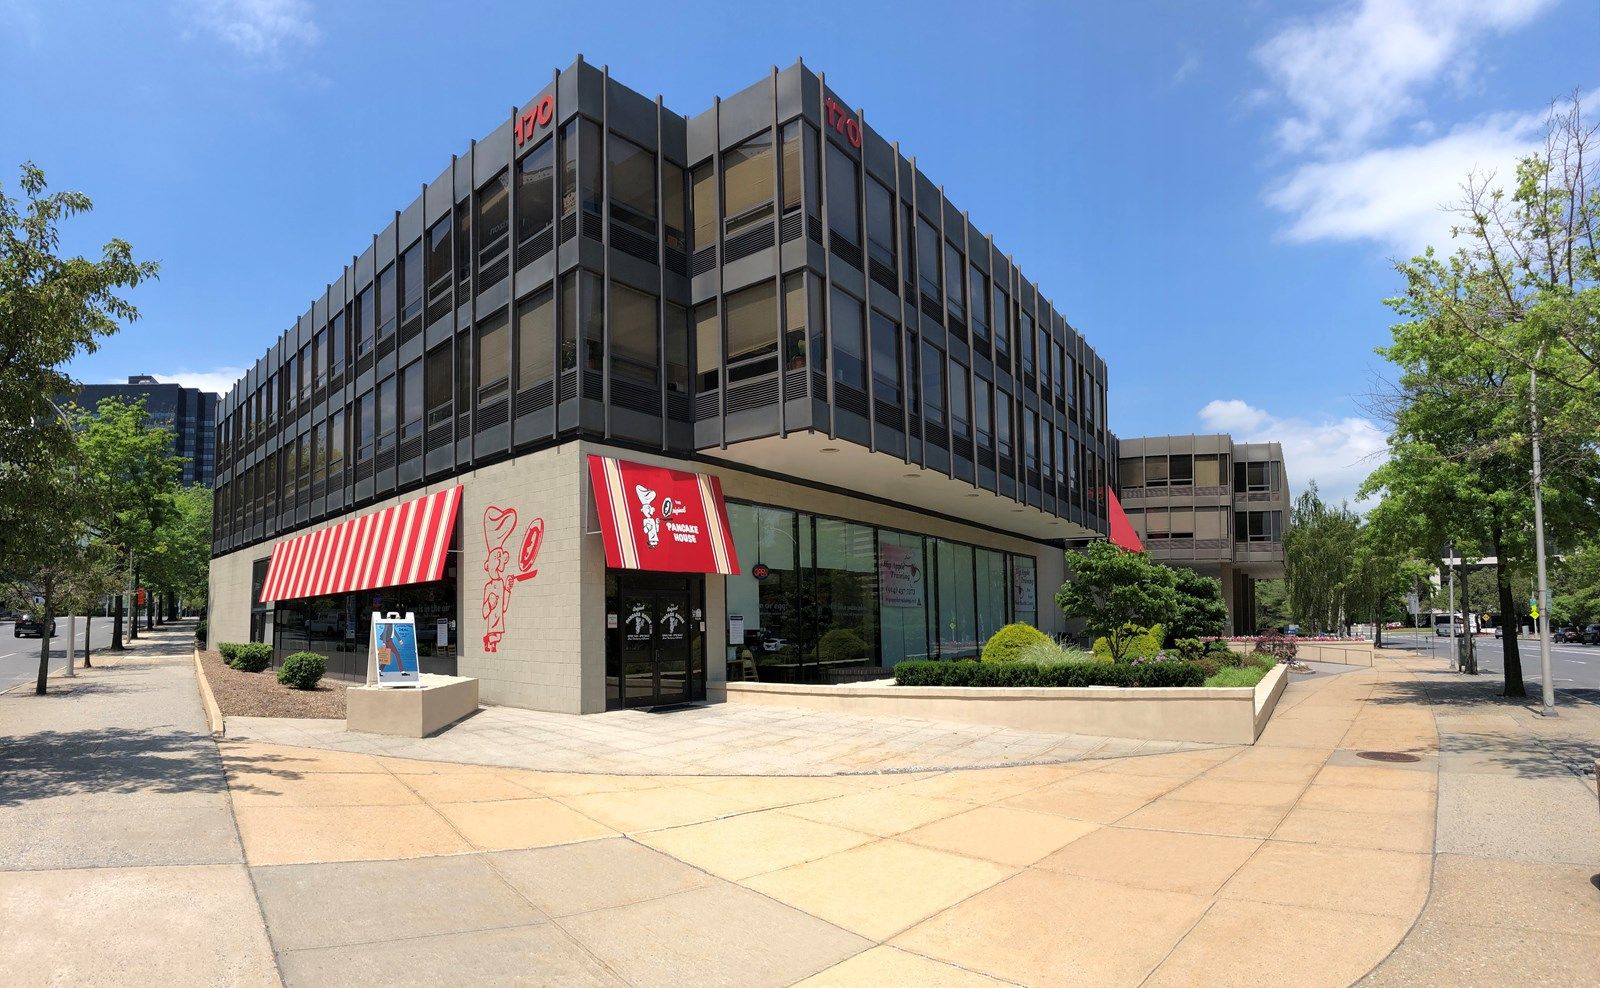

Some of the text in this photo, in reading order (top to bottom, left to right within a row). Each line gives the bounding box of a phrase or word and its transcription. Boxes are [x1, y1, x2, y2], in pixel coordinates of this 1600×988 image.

[514, 95, 553, 146] 170
[825, 97, 861, 149] 170
[665, 522, 699, 535] PANCAKE
[673, 532, 697, 543] HOUSE
